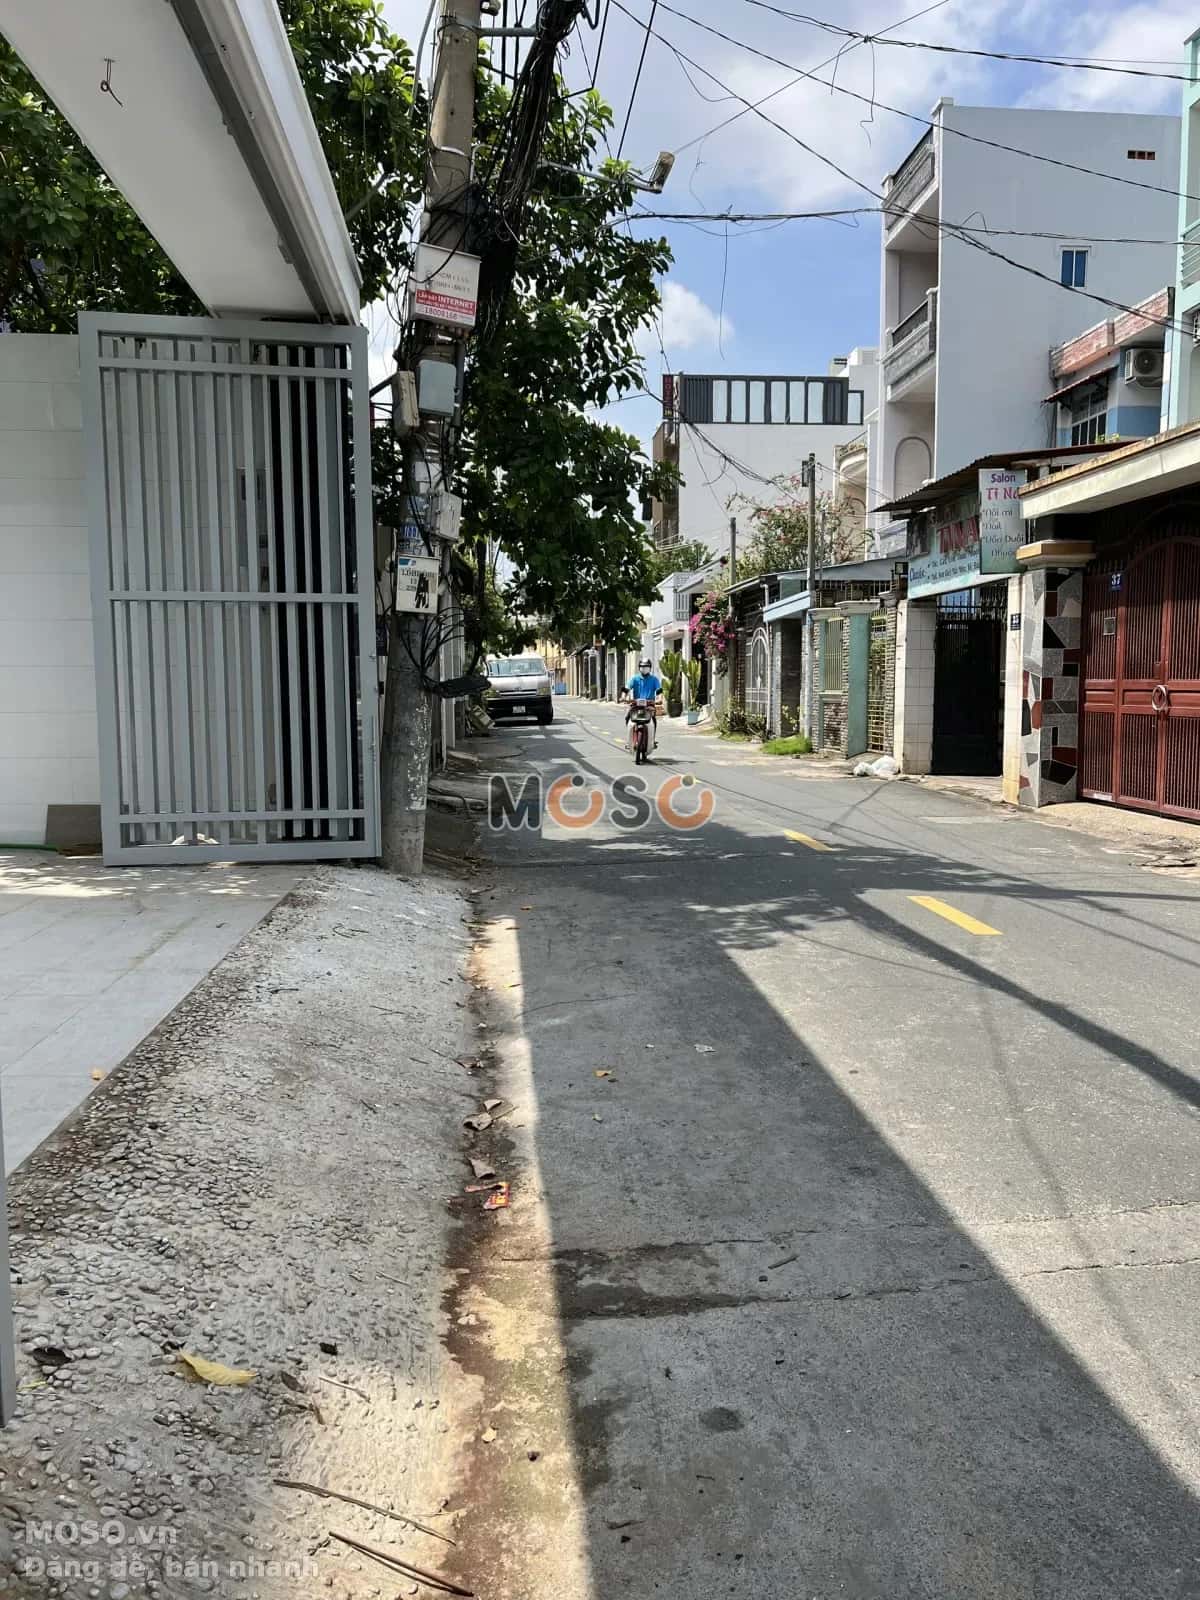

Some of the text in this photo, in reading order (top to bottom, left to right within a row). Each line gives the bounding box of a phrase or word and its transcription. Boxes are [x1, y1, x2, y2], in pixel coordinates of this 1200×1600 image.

[438, 295, 474, 310] INTERNET
[991, 473, 1016, 484] Salon
[1111, 573, 1121, 585] 37
